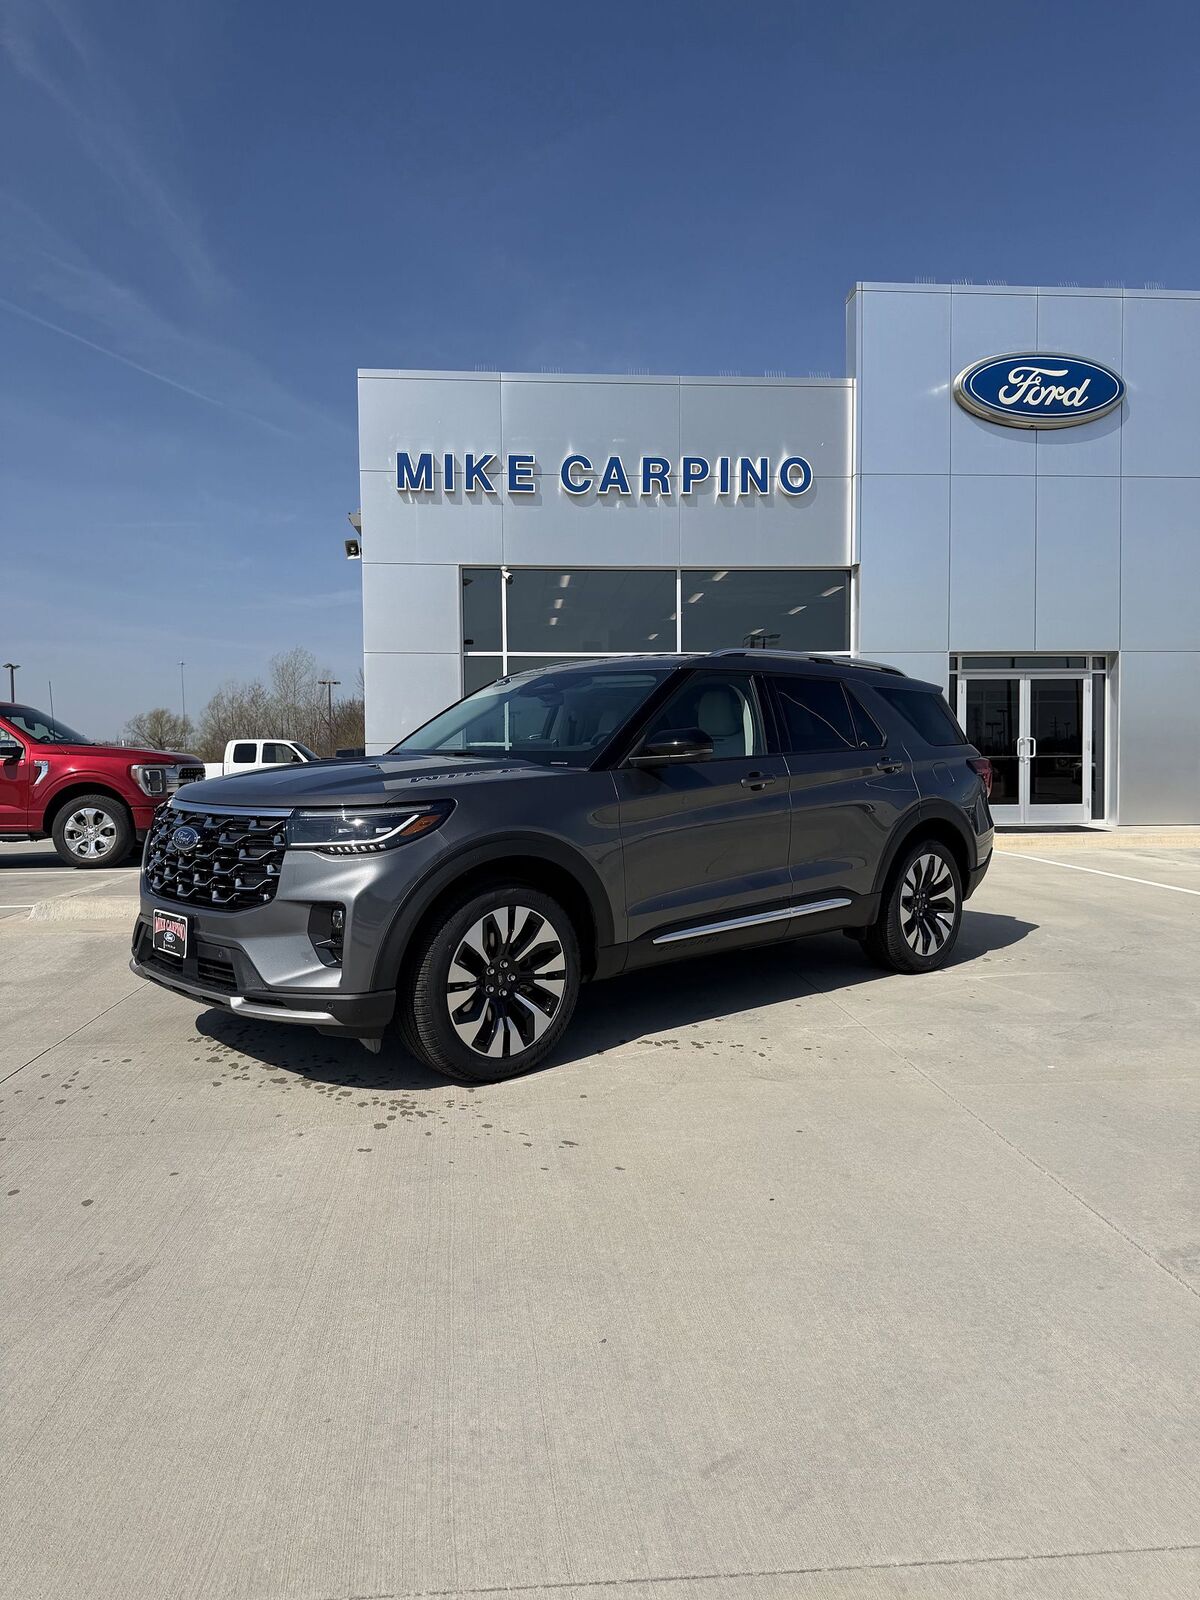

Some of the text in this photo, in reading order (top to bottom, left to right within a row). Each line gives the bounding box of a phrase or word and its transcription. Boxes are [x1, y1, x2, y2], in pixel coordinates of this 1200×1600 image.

[999, 366, 1091, 407] Ford
[396, 452, 813, 496] MIKE CARPINO
